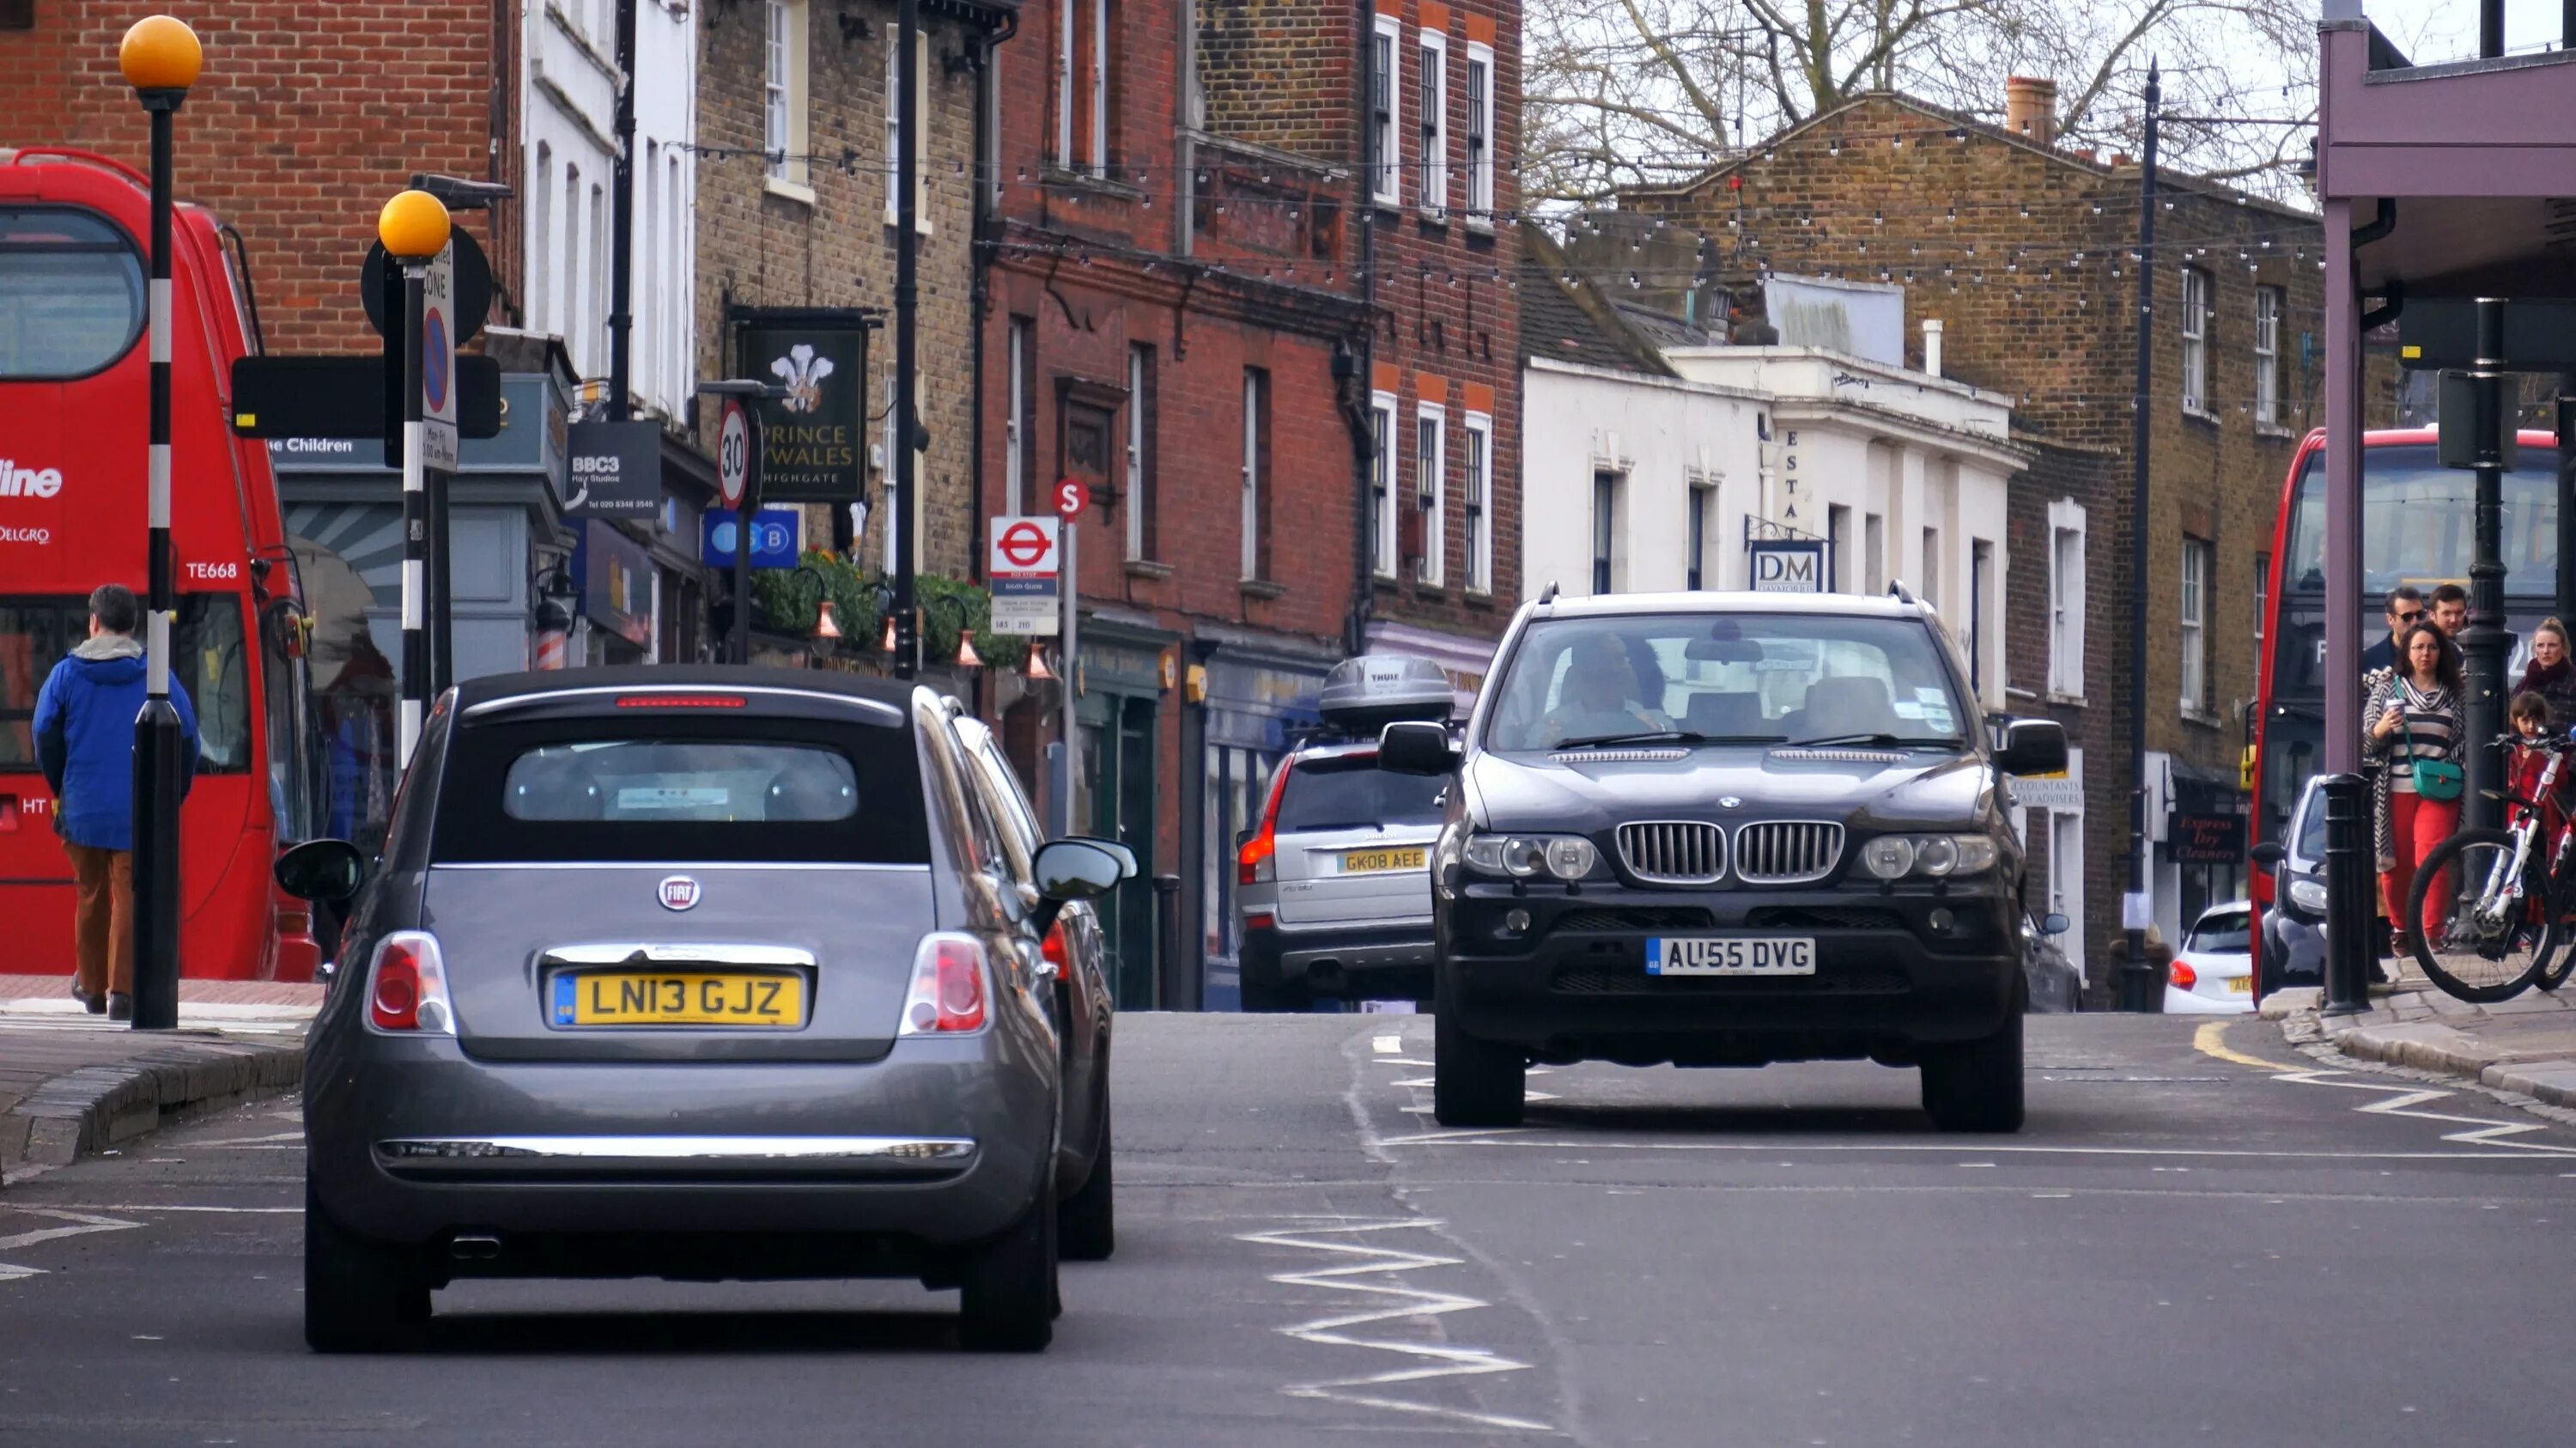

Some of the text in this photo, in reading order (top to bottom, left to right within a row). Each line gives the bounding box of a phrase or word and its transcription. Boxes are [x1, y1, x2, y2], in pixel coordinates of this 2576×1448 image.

[422, 269, 446, 299] ONE
[287, 439, 352, 453] Children
[722, 433, 744, 478] 30
[770, 447, 853, 465] WALES
[572, 456, 619, 473] BBC3
[572, 474, 620, 483] Hair Studios
[763, 473, 838, 484] HIGHGATE
[1060, 484, 1079, 513] S
[186, 563, 237, 578] TE668
[1759, 553, 1814, 581] DM
[1371, 673, 1400, 682] THULE
[2181, 817, 2232, 831] Express
[2195, 830, 2220, 848] Dry
[1346, 852, 1423, 871] GK08 AEE
[2176, 846, 2235, 860] Cleaners
[666, 885, 692, 902] FIAT
[1668, 941, 1809, 968] AU55 DVG
[592, 979, 782, 1016] LN13 GJZ
